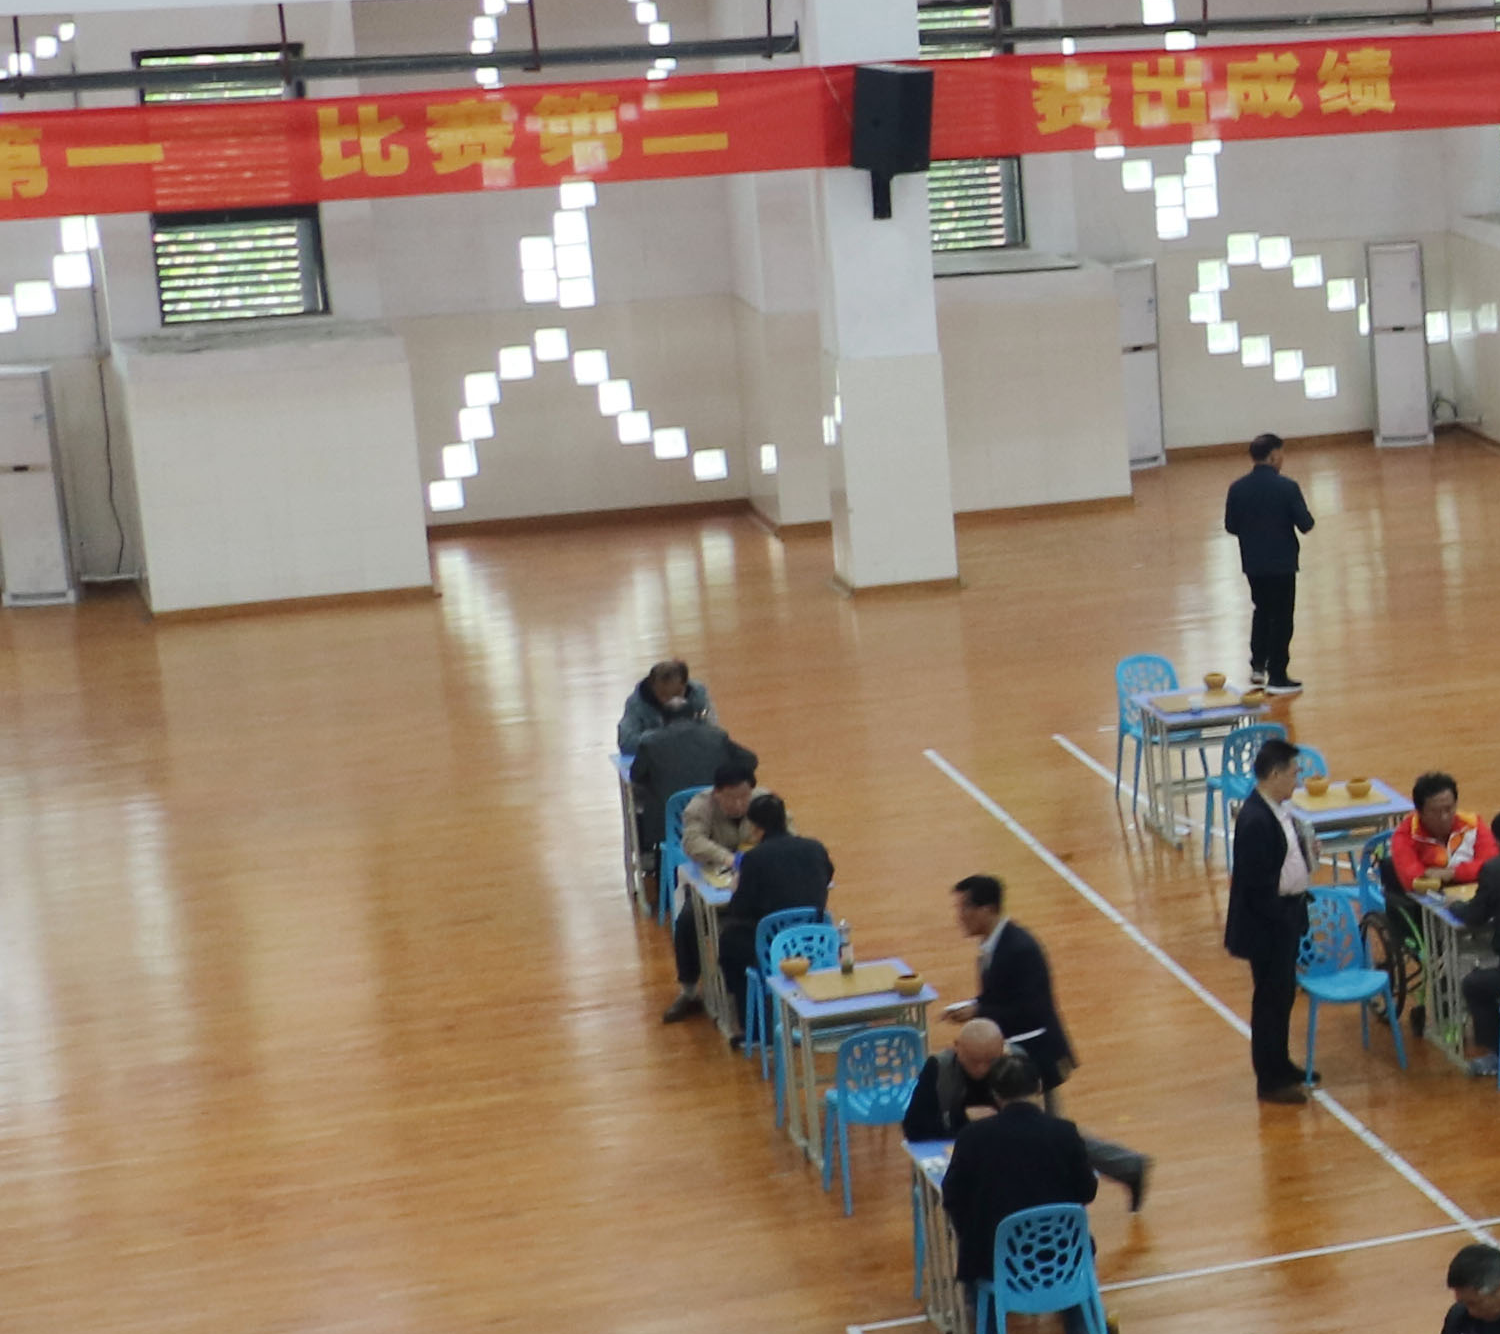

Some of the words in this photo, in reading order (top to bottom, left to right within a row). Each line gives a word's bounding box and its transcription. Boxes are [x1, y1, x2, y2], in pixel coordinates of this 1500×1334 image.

[317, 92, 729, 179] 比赛第二
[1030, 48, 1396, 134] 赛出成绩
